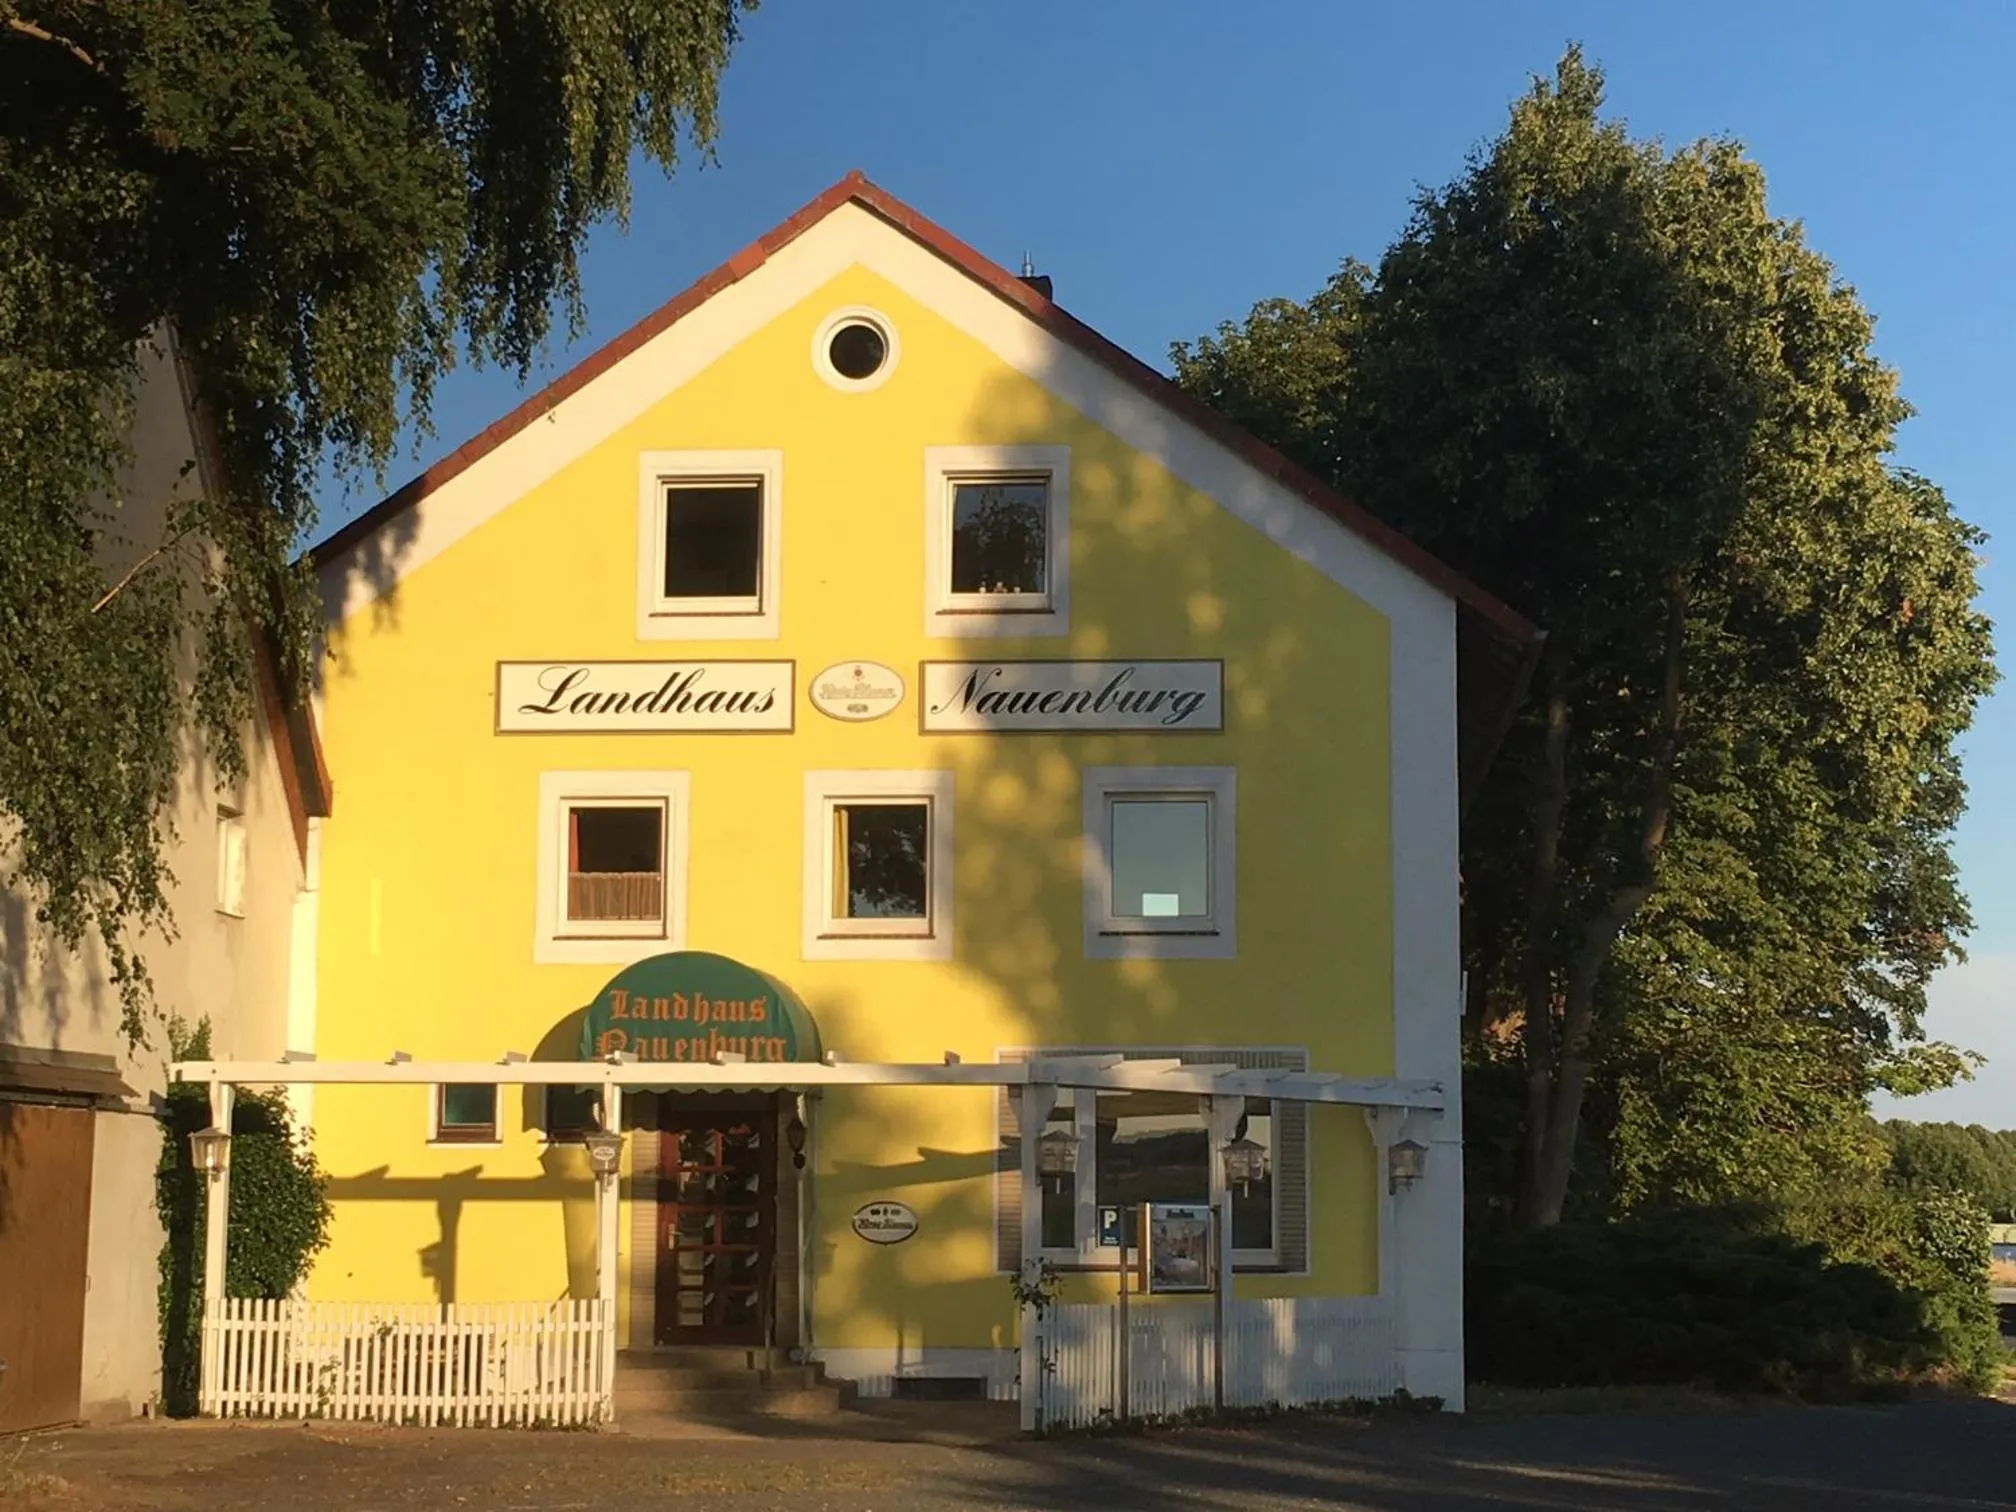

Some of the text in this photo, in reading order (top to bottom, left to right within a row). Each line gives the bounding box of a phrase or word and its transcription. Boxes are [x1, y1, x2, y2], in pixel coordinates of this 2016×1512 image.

[518, 666, 776, 714] Landhaus
[930, 667, 1206, 725] Nauenburg
[609, 989, 767, 1025] Landhaus
[1104, 1210, 1118, 1229] P
